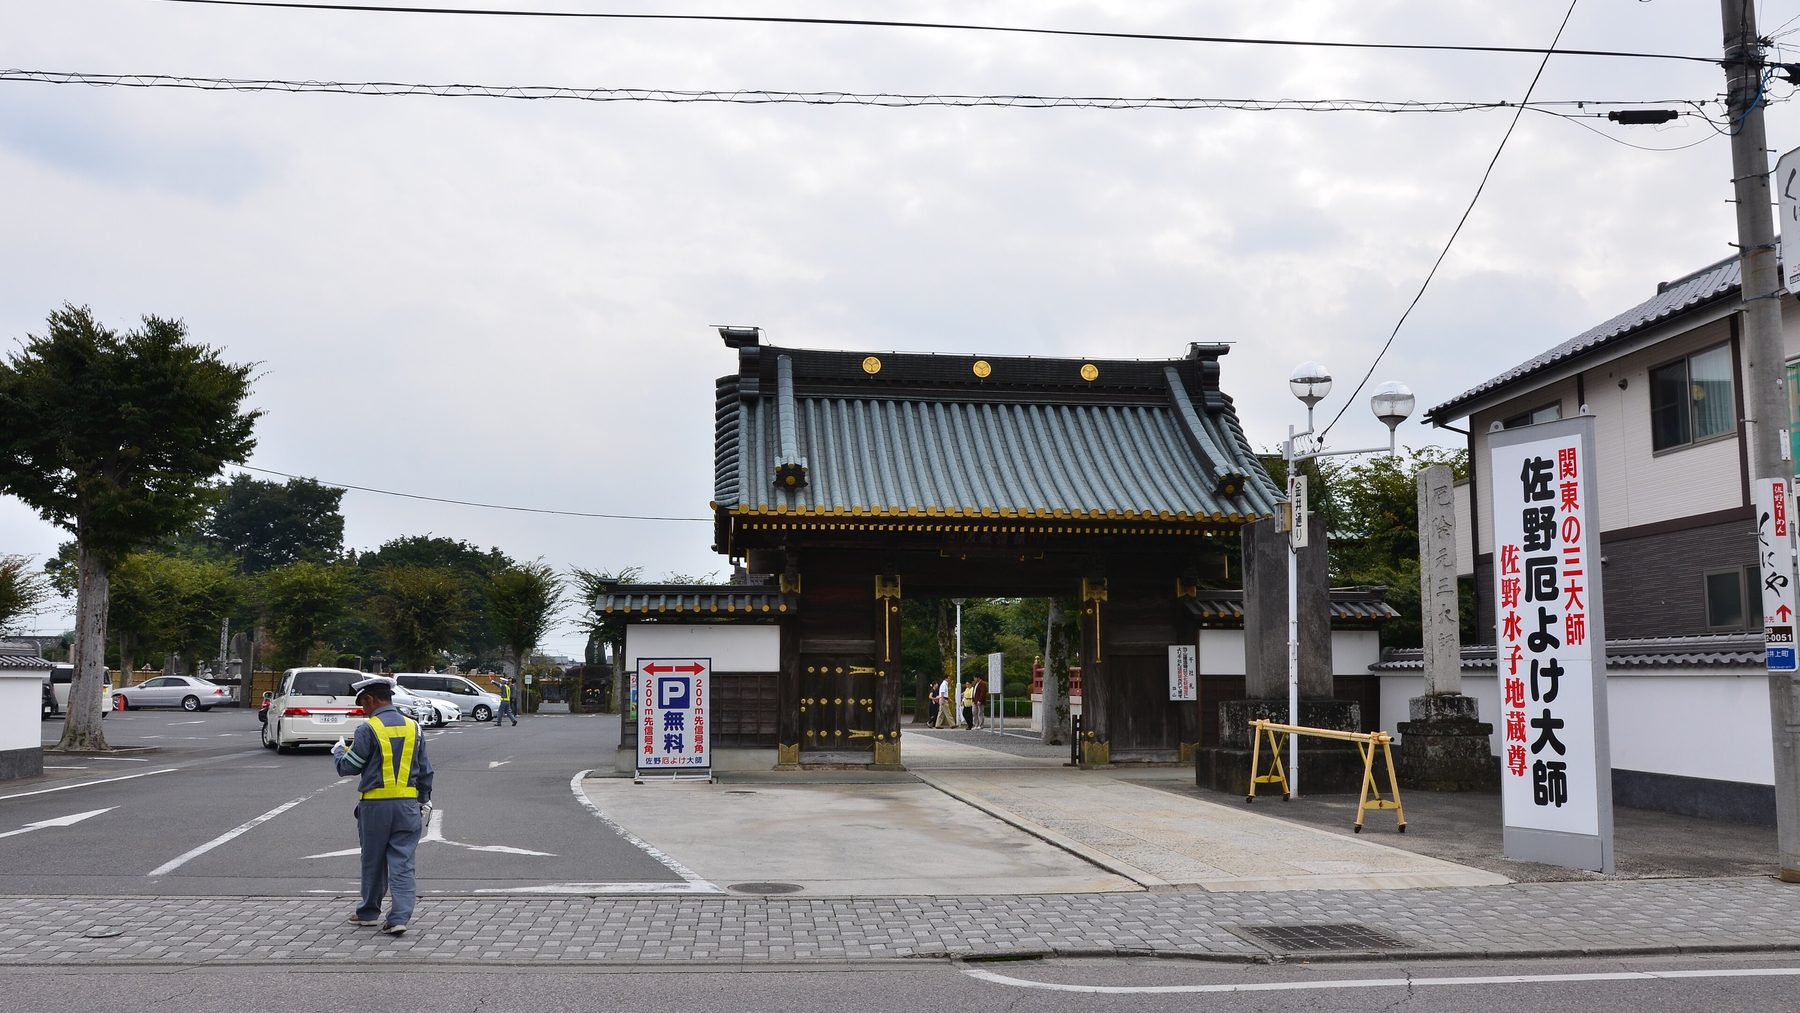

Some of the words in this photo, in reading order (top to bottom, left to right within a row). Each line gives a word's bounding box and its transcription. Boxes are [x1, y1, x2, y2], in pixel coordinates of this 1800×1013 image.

[1558, 447, 1585, 646] 関東の三大師
[1774, 485, 1785, 534] 佐野らーめん
[1759, 511, 1788, 598] くにや
[1500, 543, 1528, 777] 佐野水子地蔵尊
[1520, 456, 1568, 809] 佐野厄よけ大師
[644, 679, 653, 754] 200m先信号角
[663, 681, 685, 705] P
[694, 679, 703, 754] 200m先信号角
[645, 756, 703, 765] 佐野厄よけ大師
[663, 711, 685, 754] 無料
